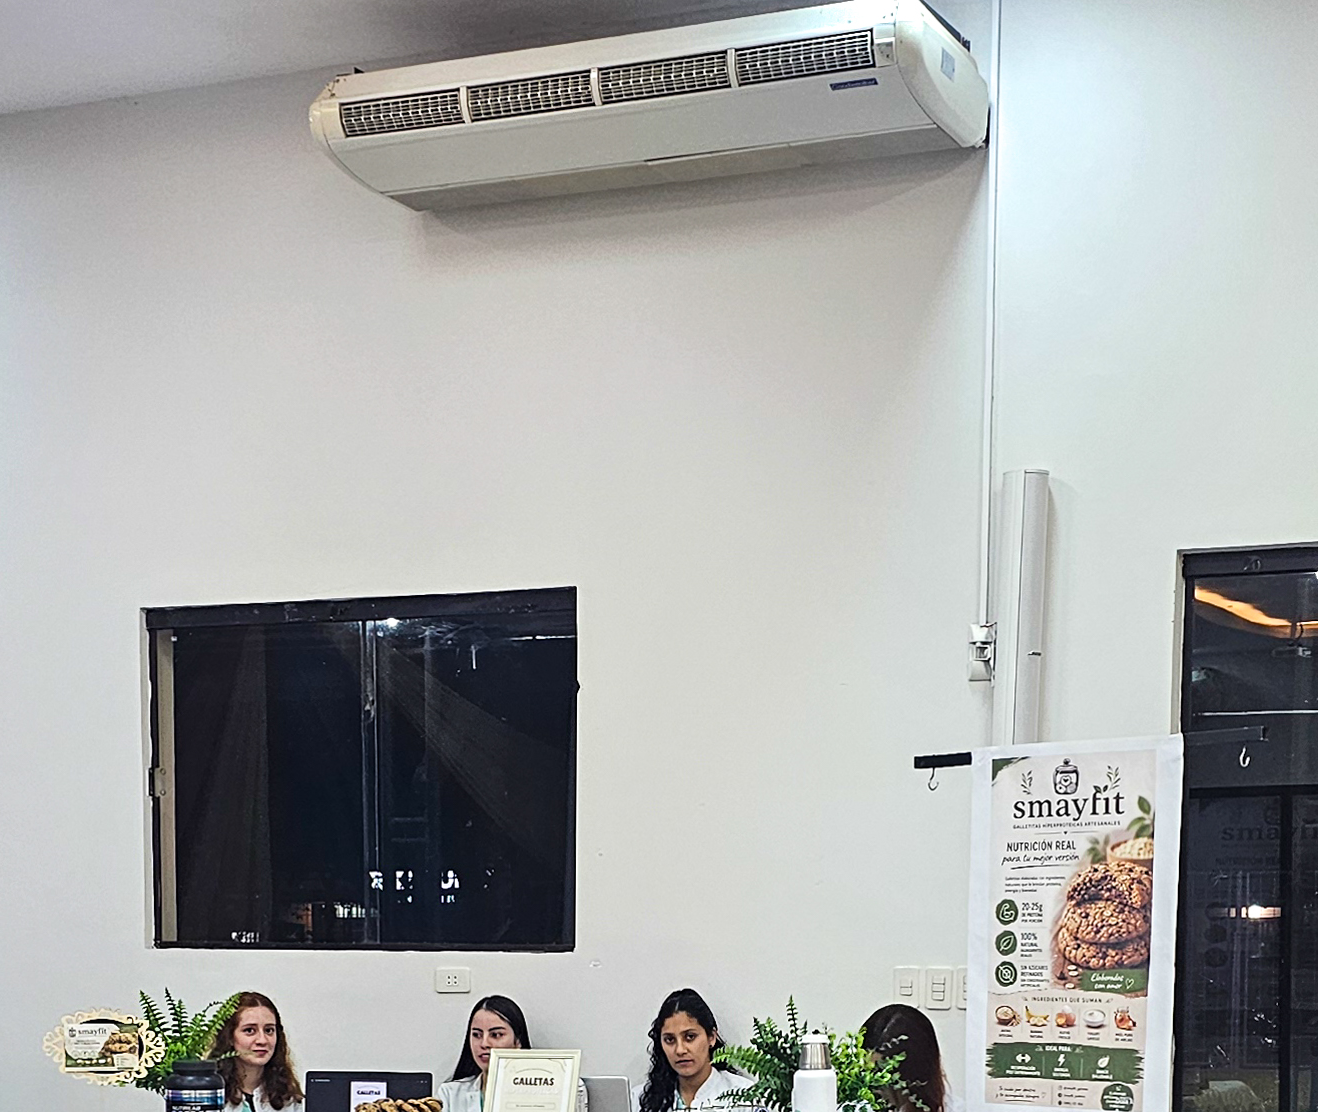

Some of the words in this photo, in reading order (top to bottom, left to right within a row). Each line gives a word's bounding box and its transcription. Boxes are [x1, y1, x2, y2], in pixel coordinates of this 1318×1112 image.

[1013, 790, 1125, 821] smayfit
[1006, 839, 1053, 852] NUTRICIÓN
[1055, 840, 1076, 851] REAL
[1001, 855, 1021, 866] para
[1032, 853, 1053, 865] mejor
[1055, 852, 1080, 862] versión
[1020, 932, 1038, 940] 100%
[78, 1027, 107, 1036] smayfit
[512, 1077, 555, 1086] GALLETAS
